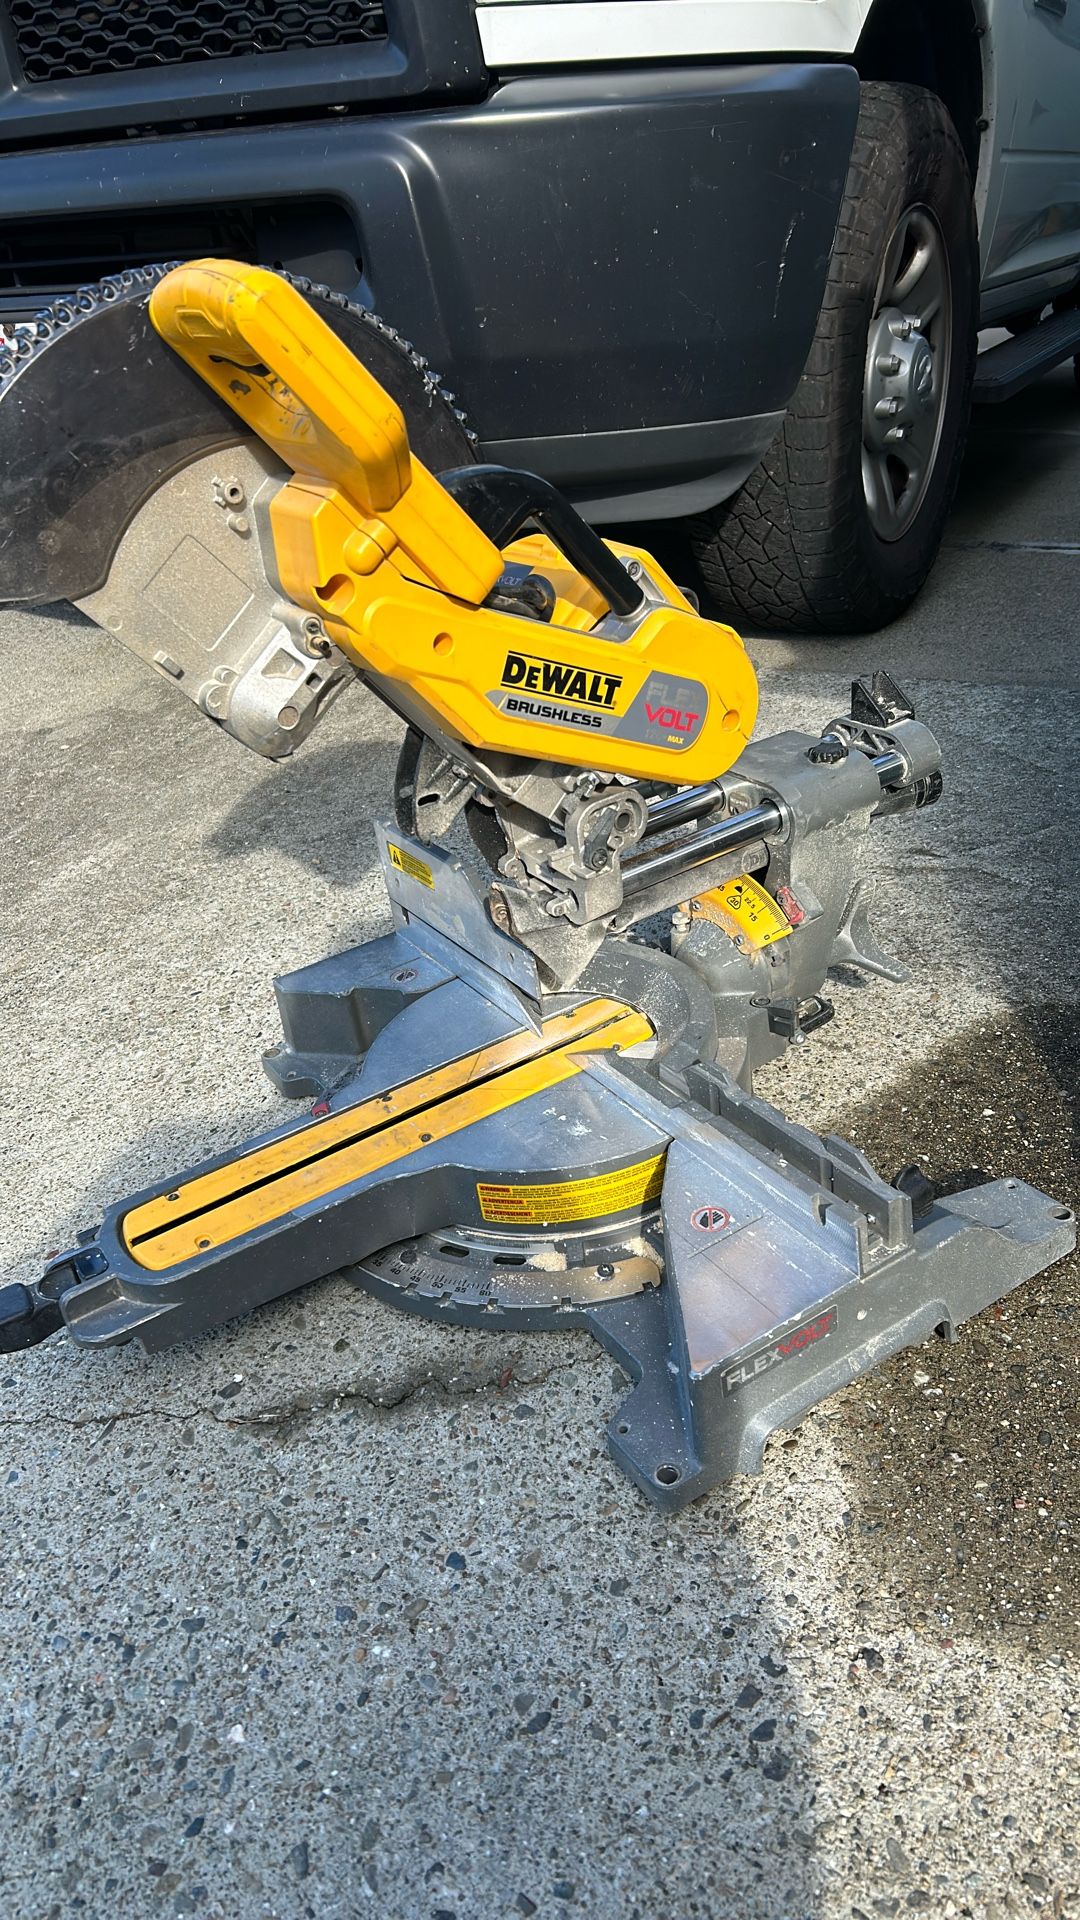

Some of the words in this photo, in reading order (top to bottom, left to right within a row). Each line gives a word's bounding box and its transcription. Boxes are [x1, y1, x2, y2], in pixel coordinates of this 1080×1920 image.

[506, 699, 602, 728] BRUSHLESS
[644, 703, 700, 733] VOLT
[667, 735, 685, 745] MAX
[730, 897, 739, 907] 30
[744, 897, 756, 909] 22.5
[748, 912, 759, 922] 15
[372, 1259, 383, 1267] 35
[410, 1275, 422, 1283] 45
[431, 1281, 444, 1289] 50
[454, 1286, 467, 1294] 55
